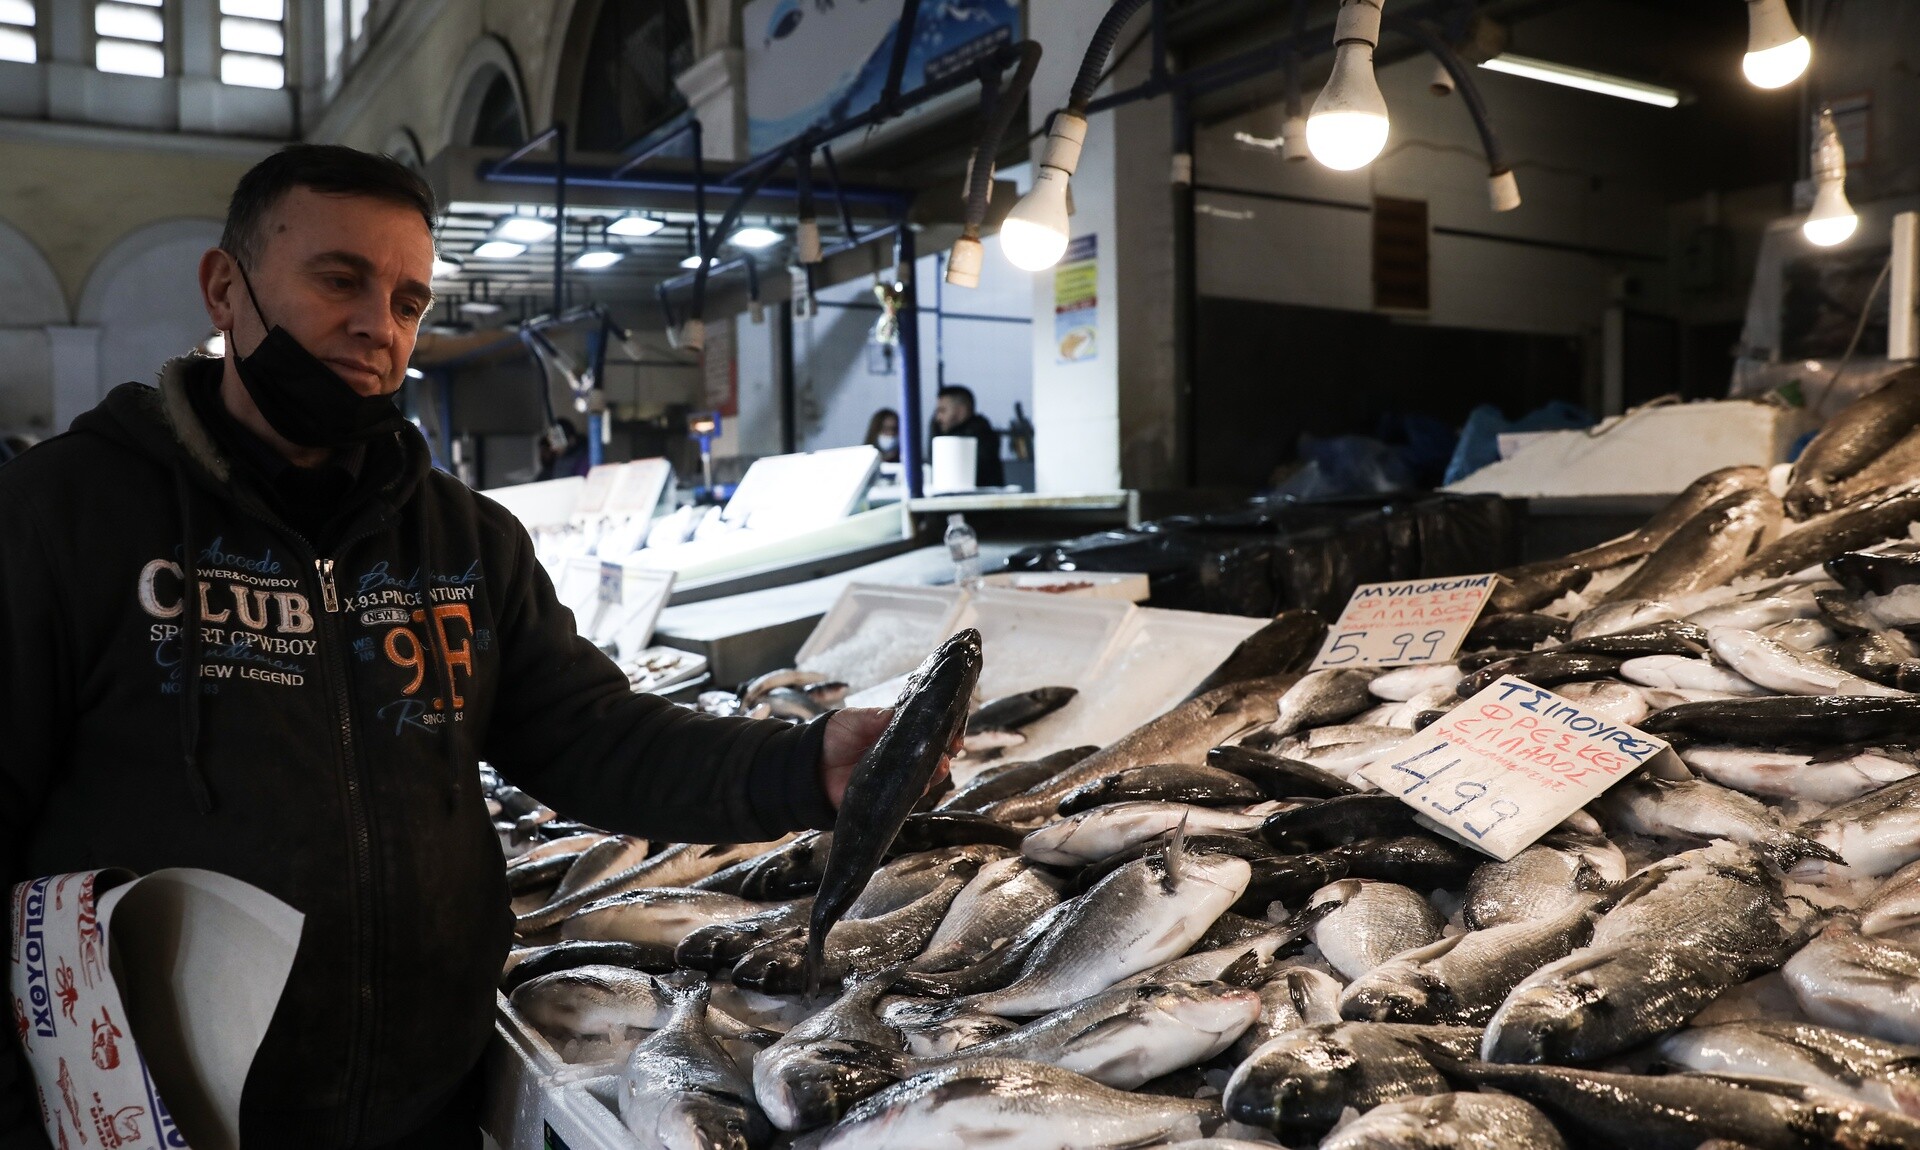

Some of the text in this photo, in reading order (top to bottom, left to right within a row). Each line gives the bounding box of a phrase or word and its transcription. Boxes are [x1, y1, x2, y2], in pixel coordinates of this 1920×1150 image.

[137, 558, 315, 634] CLUB
[1354, 576, 1490, 600] ΜΥΛΟΚΟΠΙΑ
[1357, 589, 1483, 609] ΦΡΕΣΚΑ
[1345, 602, 1476, 621] ΕΛΛΑΔΟΣ
[150, 624, 225, 646] SPRT
[1322, 630, 1446, 664] 5.99
[239, 667, 305, 687] LEGEND
[1480, 703, 1629, 775] ΦΡΕΣΚΕΣ
[1499, 681, 1661, 763] ΤΣΙΠΟΥΡΕΣ
[1453, 718, 1600, 787] ΕΛΛΑΔΟΣ
[1391, 741, 1520, 839] 4.99
